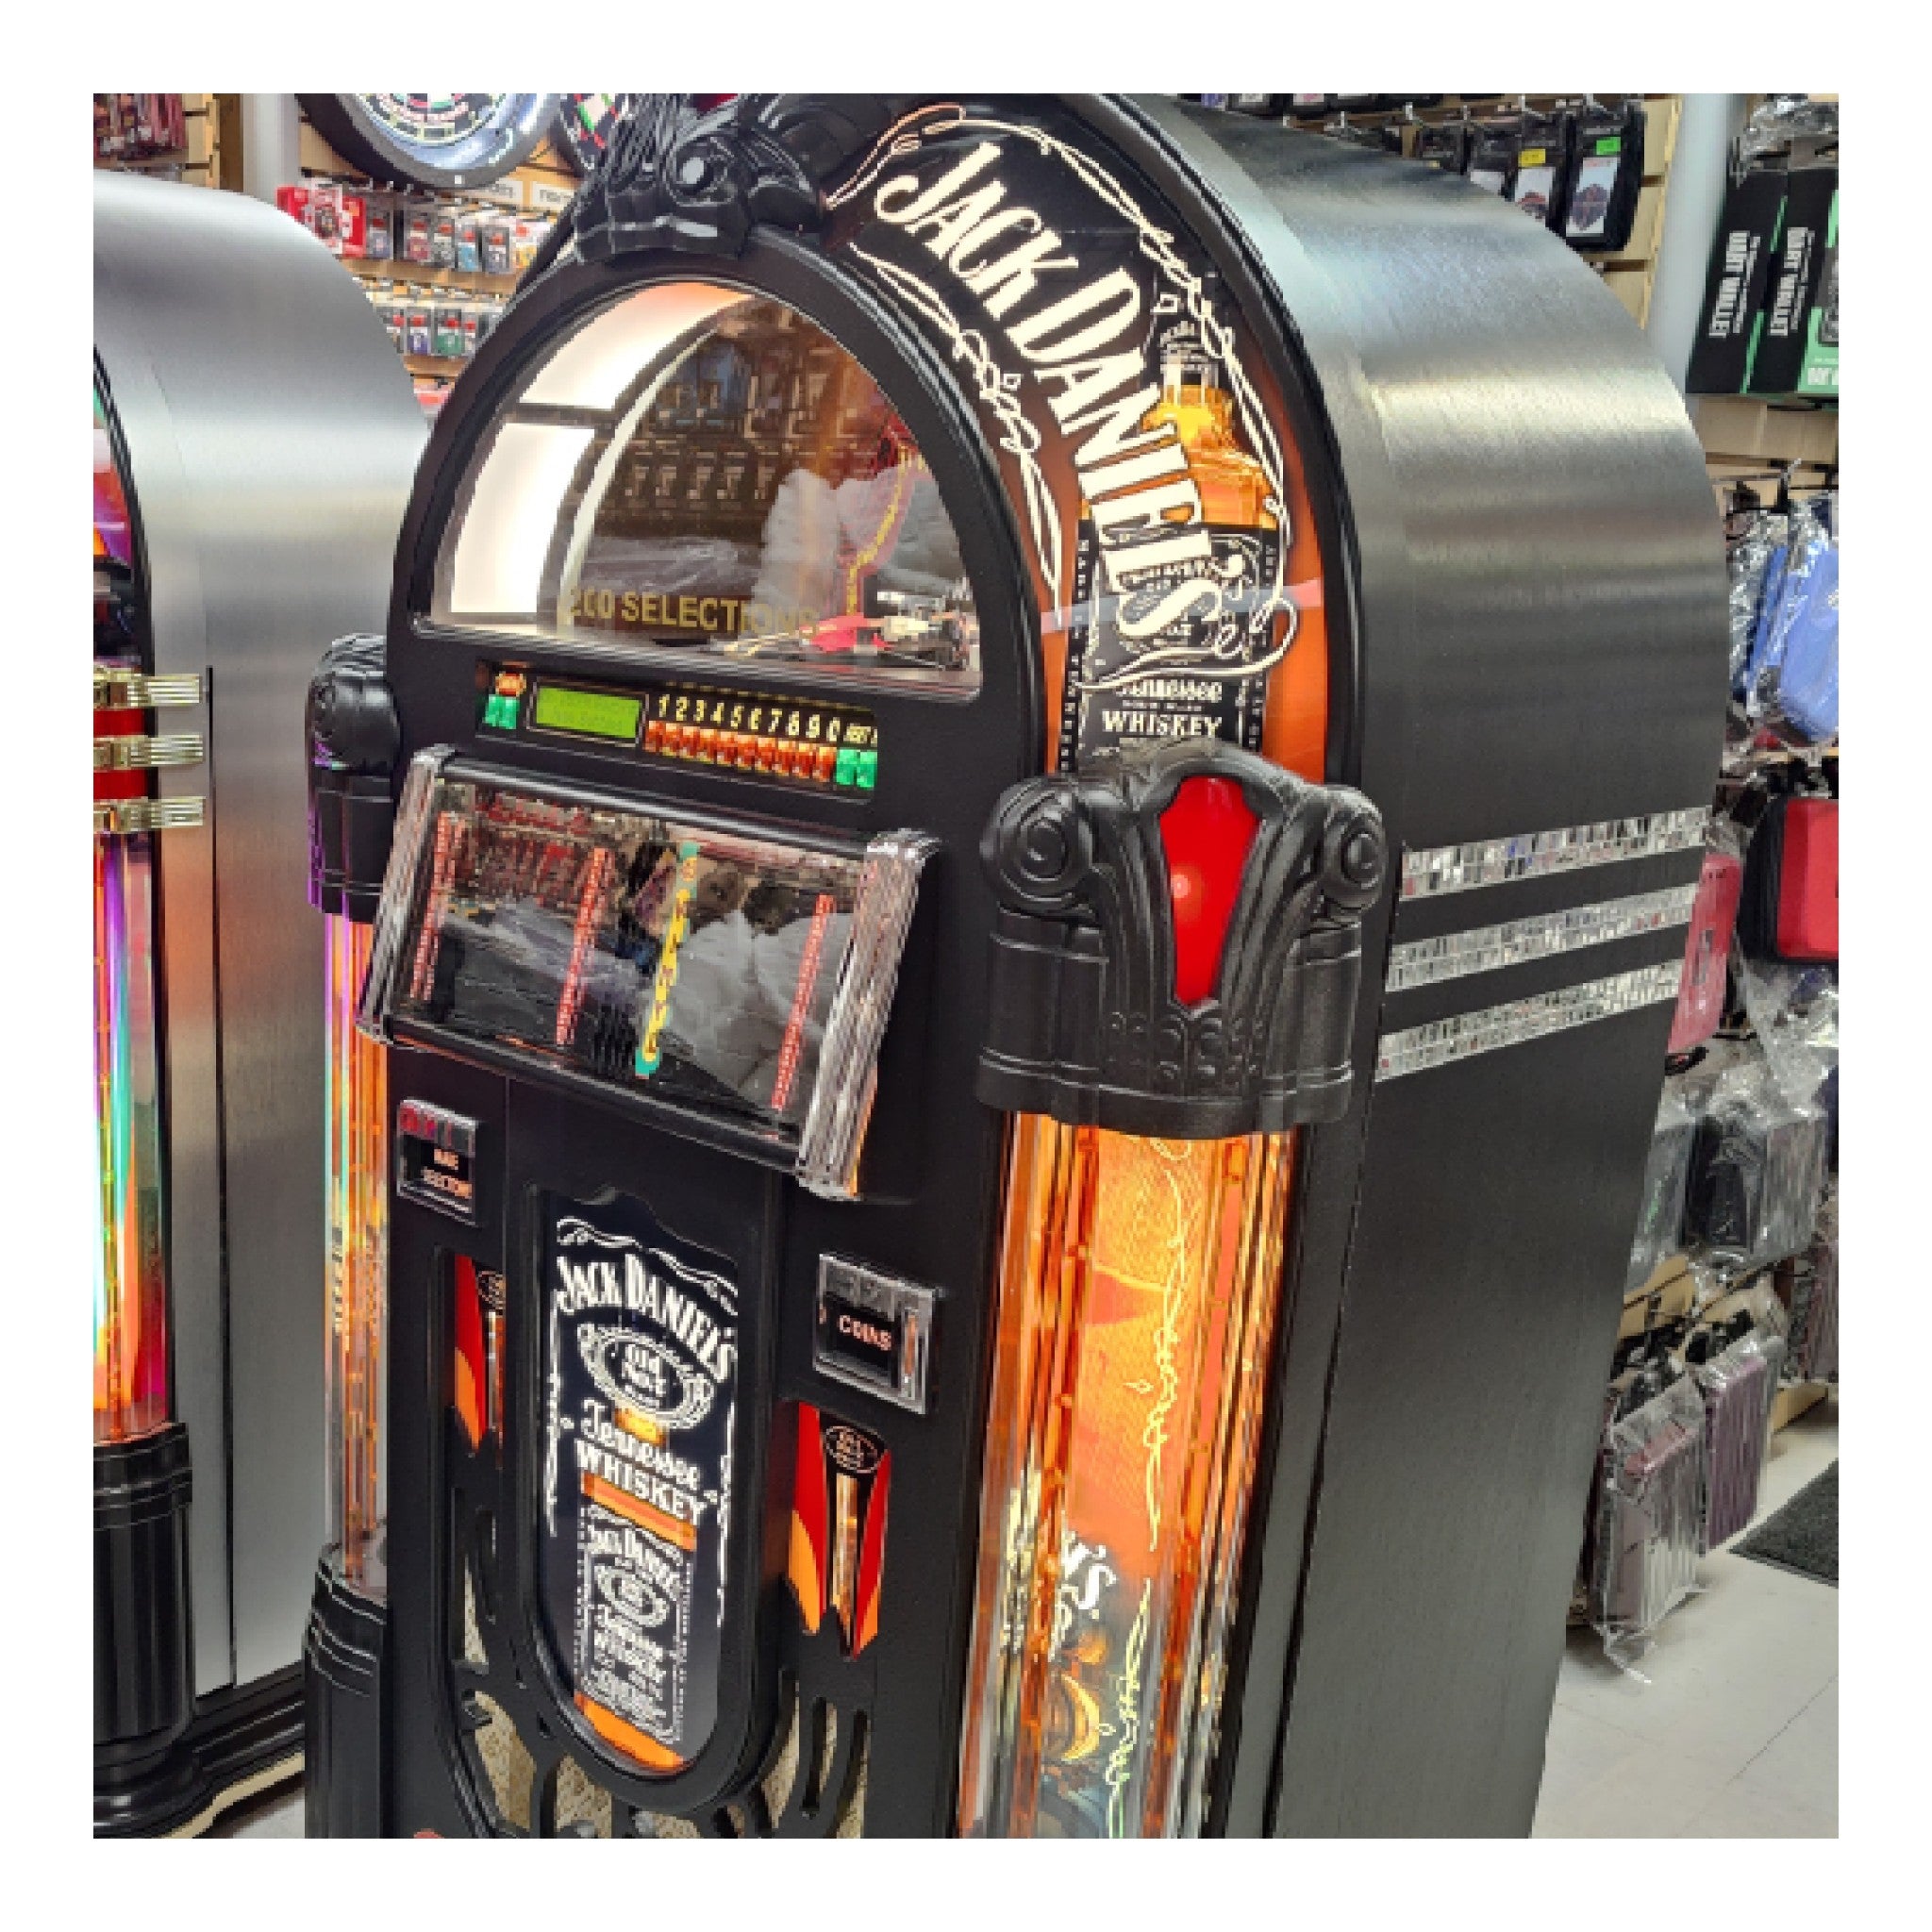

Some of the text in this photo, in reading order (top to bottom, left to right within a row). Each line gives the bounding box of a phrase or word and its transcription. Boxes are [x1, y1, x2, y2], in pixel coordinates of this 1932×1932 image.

[873, 141, 1079, 320] JACK
[658, 694, 670, 717] 1
[675, 696, 690, 721] 2
[693, 699, 707, 722] 3
[710, 702, 724, 725] 4
[730, 705, 744, 728] 5
[768, 708, 782, 733] 7
[805, 714, 821, 739] 9
[1102, 710, 1223, 736] WHISKEY
[556, 1253, 623, 1316] JACK
[575, 1438, 707, 1529] WHISKEY
